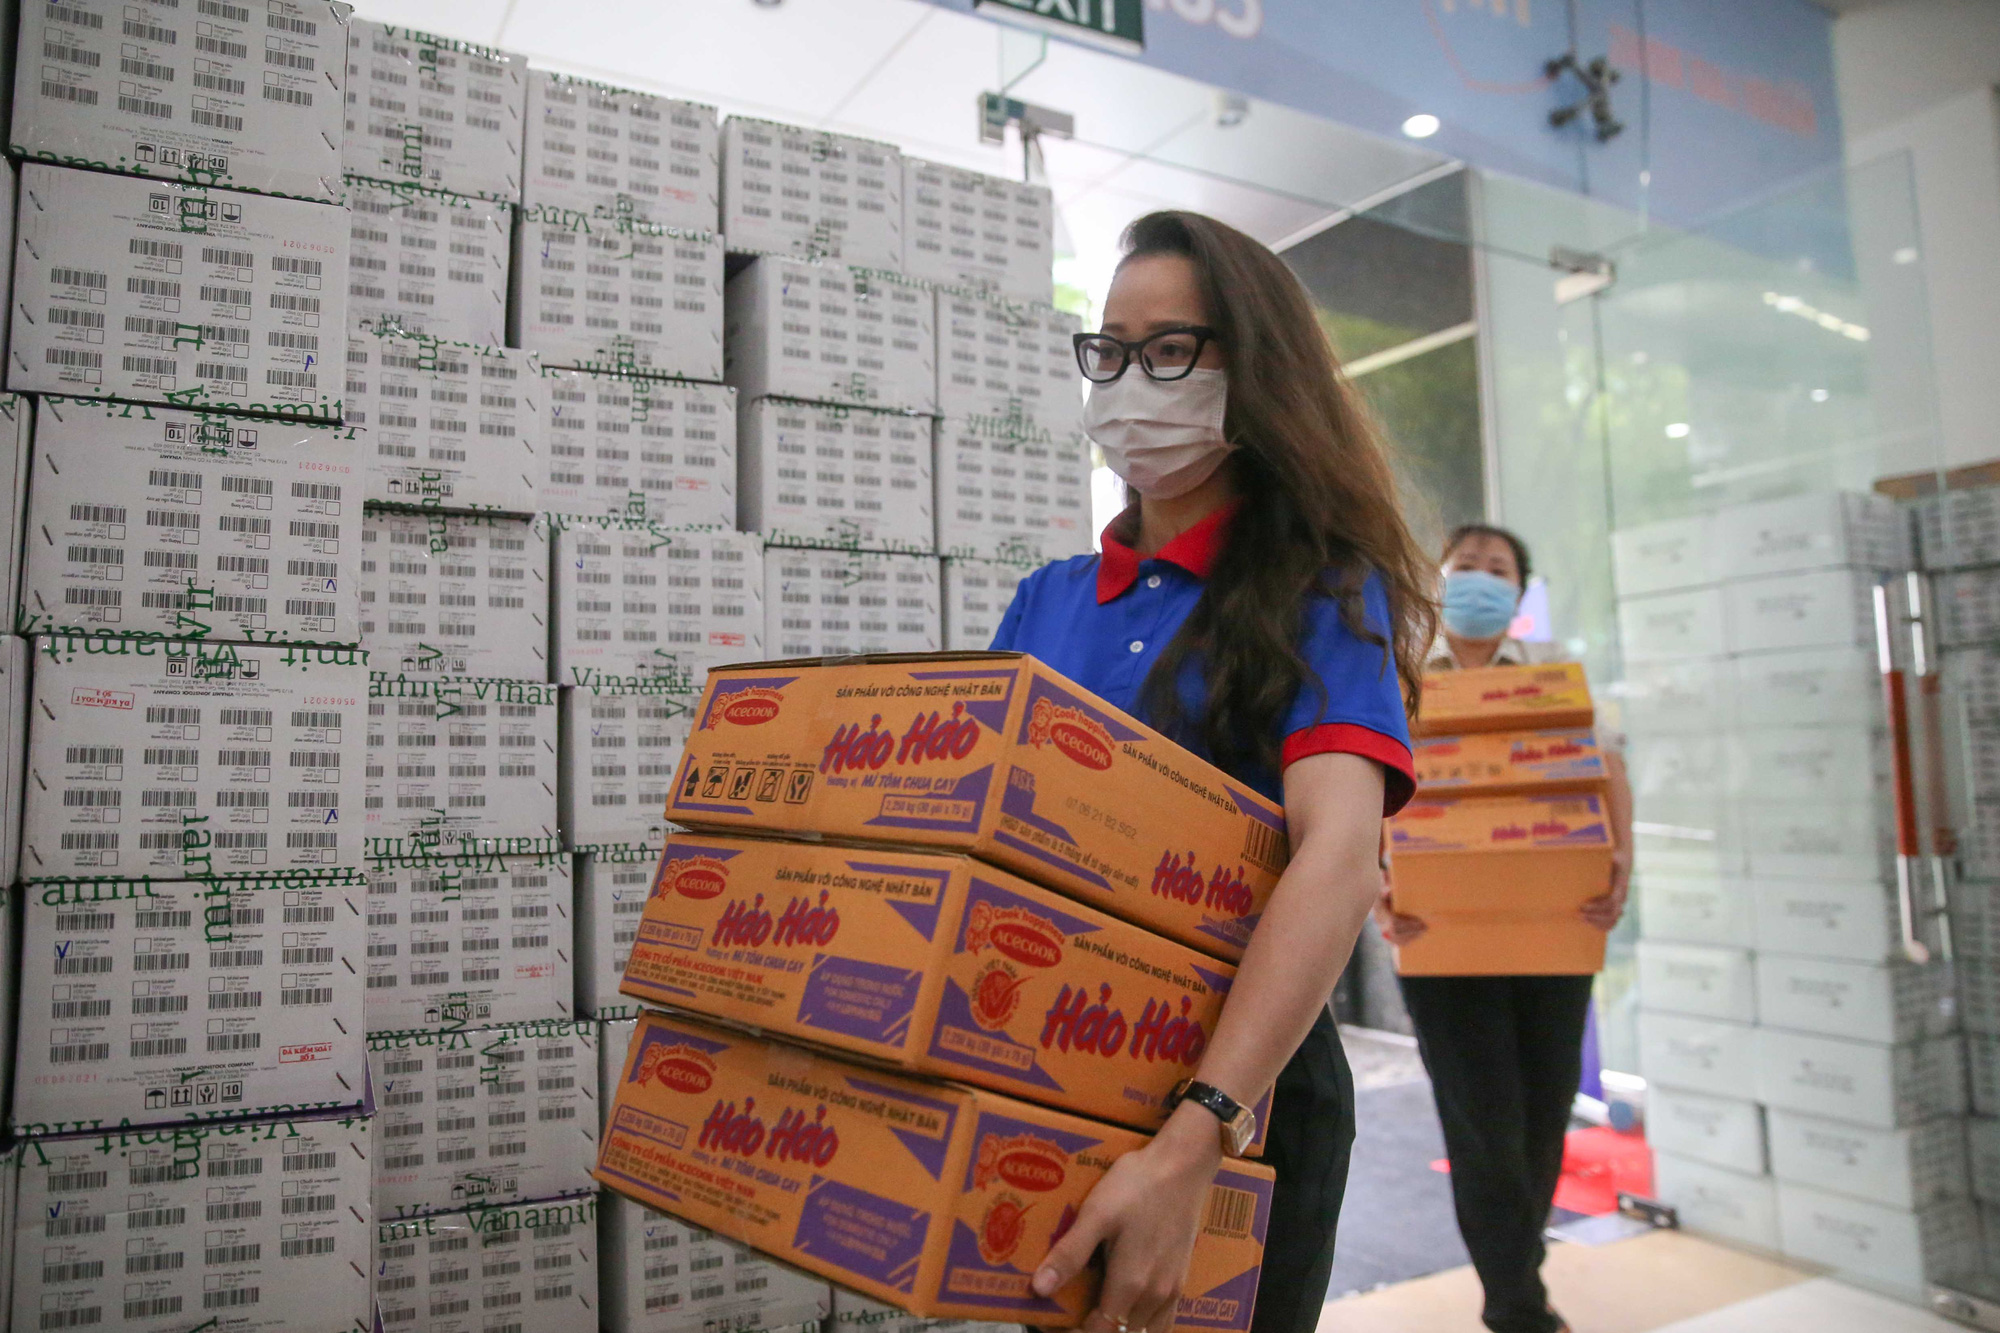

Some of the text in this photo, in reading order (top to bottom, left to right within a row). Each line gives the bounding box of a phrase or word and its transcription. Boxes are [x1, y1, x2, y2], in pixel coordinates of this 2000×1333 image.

[152, 201, 167, 210] 10
[168, 430, 182, 440] 10
[170, 662, 182, 674] 10
[836, 685, 853, 699] SẢN
[880, 684, 896, 697] VỚI
[896, 683, 923, 697] CÔNG
[924, 684, 951, 698] NGHỆ
[951, 682, 979, 697] NHẬT
[981, 680, 1003, 696] BẢN
[819, 700, 981, 775] Hảo Hảo
[1053, 704, 1117, 750] Cook happiness
[880, 772, 902, 789] TÔM
[903, 776, 932, 790] CHUA
[934, 778, 959, 792] CAY
[1122, 742, 1238, 816] SẢN PHẨM VỚI CÔNG NGHỆ NHẬT BẢN
[1092, 808, 1103, 822] 21
[775, 867, 794, 882] SẢN
[832, 874, 857, 890] CÔNG
[858, 877, 884, 894] NGHỆ
[885, 880, 912, 896] NHẬT
[912, 880, 934, 898] BẢN
[1151, 848, 1204, 906] Hảo
[1205, 864, 1254, 918] Hảo
[712, 888, 840, 948] Hảo Hảo
[1073, 935, 1208, 996] SẢN PHẨM VỚI CÔNG NGHỆ NHẬT BẢN
[1040, 982, 1128, 1059] Hảo
[1129, 995, 1206, 1068] Hảo
[225, 1084, 238, 1096] 10
[698, 1096, 765, 1158] Hảo
[764, 1102, 840, 1169] Hảo
[916, 1113, 940, 1132] BẢN
[1220, 1300, 1239, 1321] CAY
